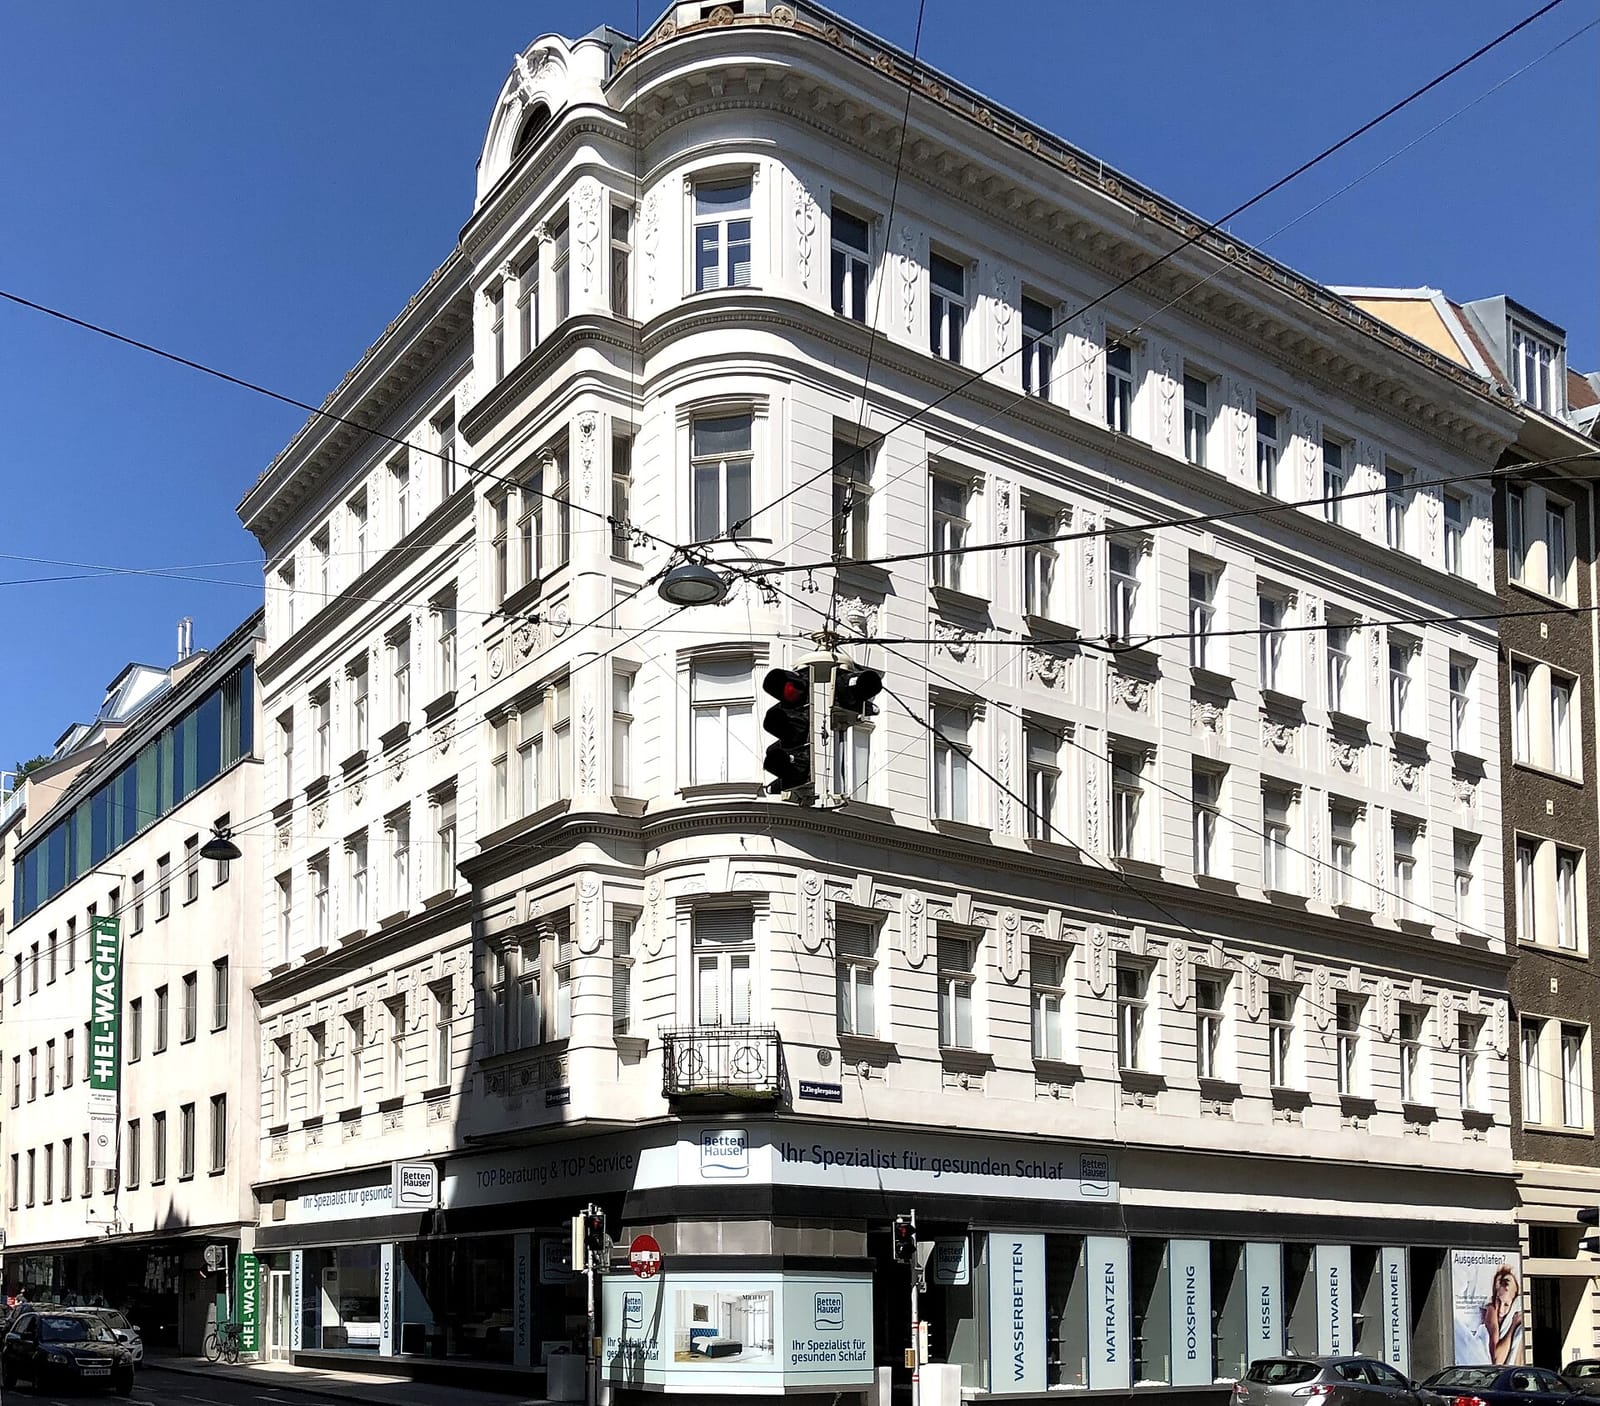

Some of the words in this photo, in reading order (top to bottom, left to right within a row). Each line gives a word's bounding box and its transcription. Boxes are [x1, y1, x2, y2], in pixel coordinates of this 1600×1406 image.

[704, 1136, 745, 1147] Betten
[704, 1146, 743, 1157] Hauser
[781, 1142, 807, 1163] Ihr
[812, 1144, 897, 1170] Spezialist
[902, 1151, 927, 1170] für
[931, 1157, 1010, 1179] gesunden
[1015, 1159, 1064, 1180] Schlaf
[1082, 1158, 1107, 1169] Betten
[403, 1171, 431, 1181] Betten
[476, 1169, 497, 1188] TOP
[500, 1165, 547, 1186] Beratung
[551, 1161, 559, 1178] &
[561, 1157, 586, 1177] TOP
[589, 1152, 633, 1174] Service
[1082, 1167, 1107, 1178] Hauser
[403, 1179, 431, 1188] Hauser
[303, 1196, 313, 1209] Ihr
[360, 1186, 393, 1206] gesunde
[1454, 1254, 1506, 1267] Ausgeschlafen?
[817, 1297, 841, 1307] Betten
[817, 1305, 841, 1314] Hauser
[1012, 1243, 1024, 1382] WASSERBETTEN
[1105, 1262, 1116, 1362] MATRATZEN
[1186, 1265, 1197, 1360] BOXSPRING
[1262, 1286, 1271, 1340] KISSEN
[1330, 1267, 1340, 1356] BETTWAREN
[1390, 1264, 1401, 1362] BETTRAHMEN
[607, 1337, 616, 1347] Ihr
[792, 1340, 804, 1351] Ihr
[807, 1338, 850, 1355] Spezialist
[852, 1338, 866, 1350] für
[791, 1350, 837, 1365] gesunden
[838, 1350, 867, 1362] Schlaf
